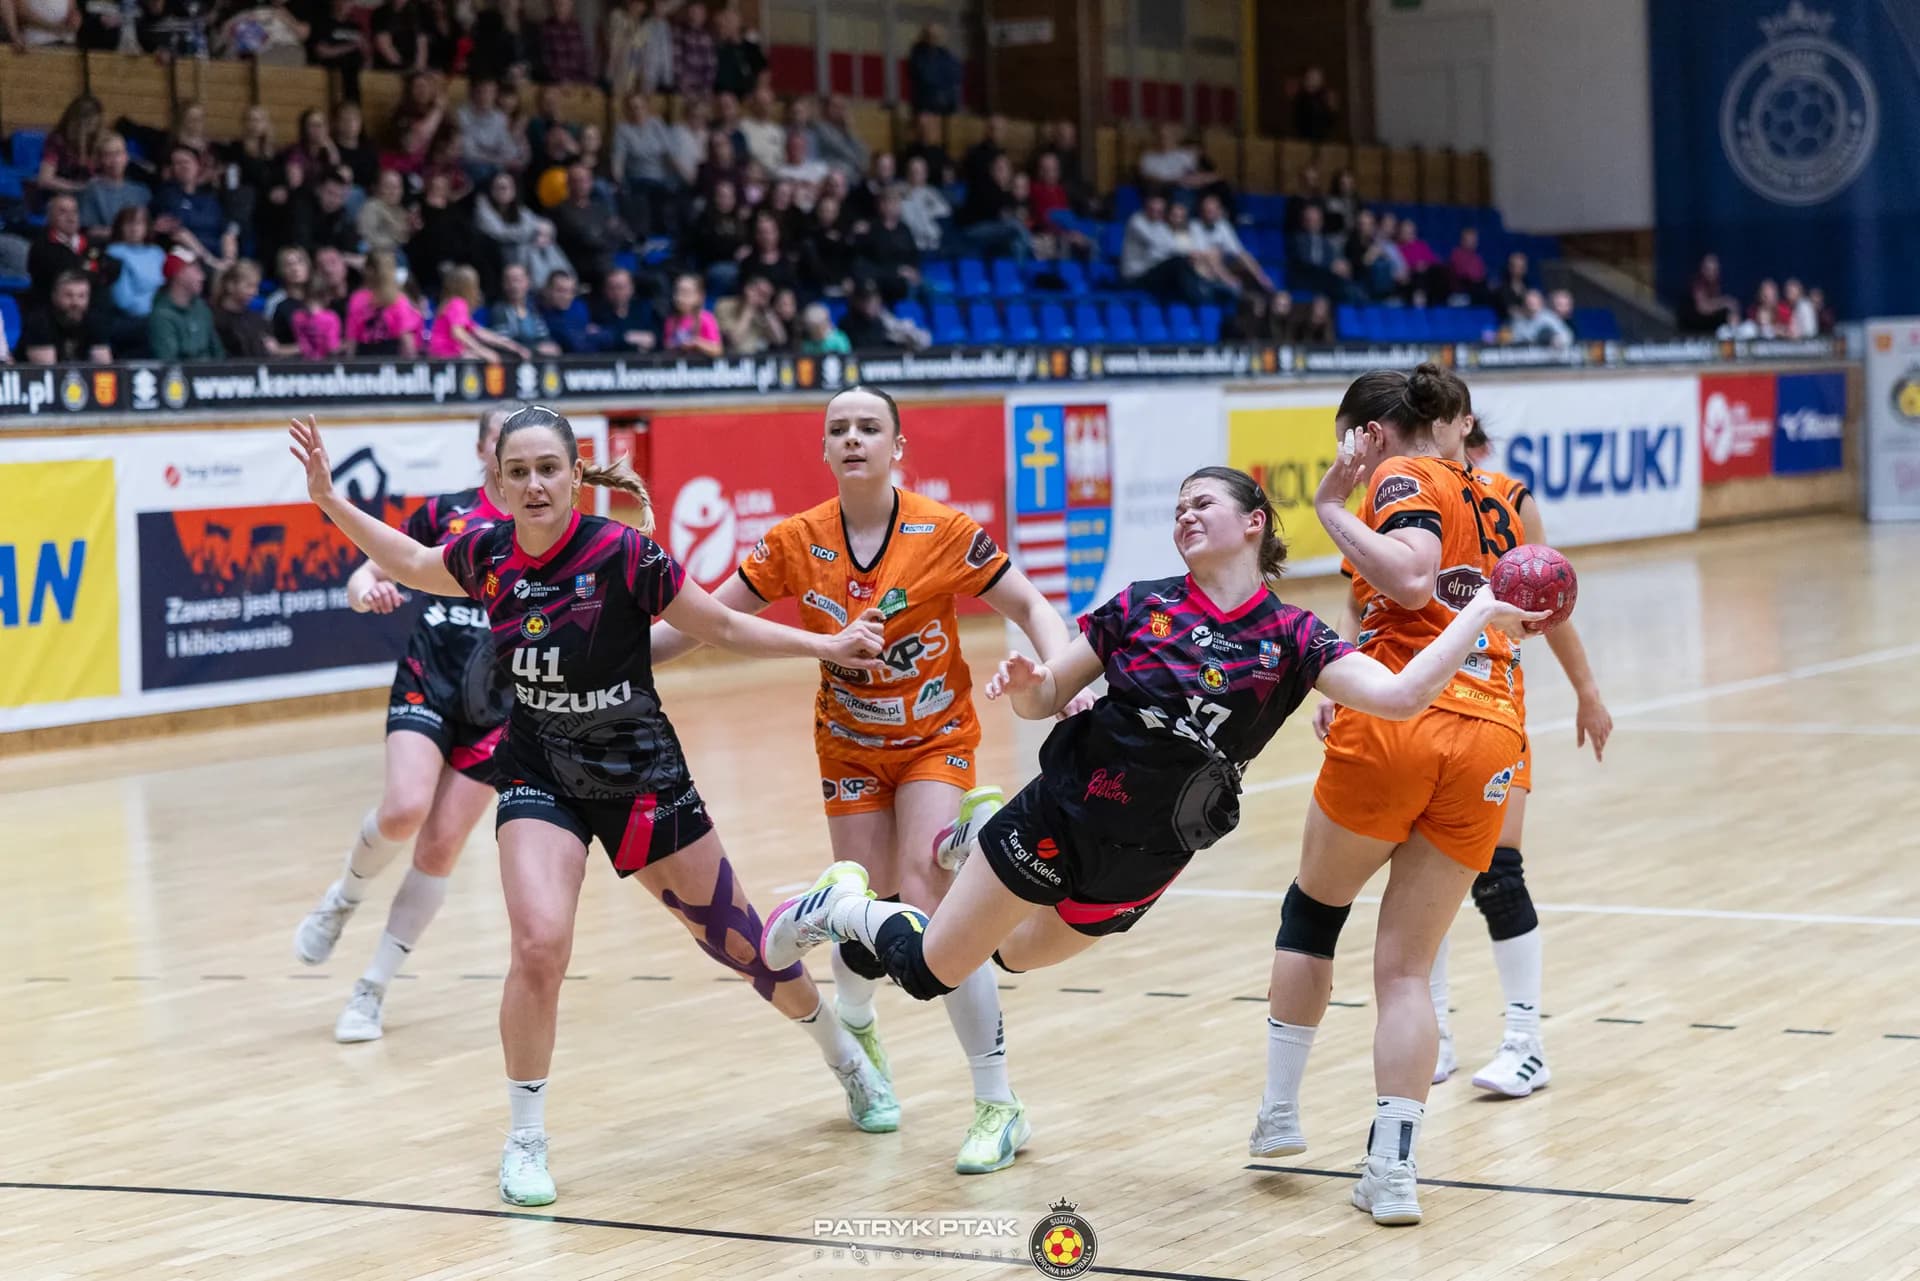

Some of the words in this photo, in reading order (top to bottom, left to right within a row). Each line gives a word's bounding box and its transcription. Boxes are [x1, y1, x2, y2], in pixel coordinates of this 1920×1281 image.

[0, 370, 54, 414] ll.pl
[193, 364, 456, 402] www.koronahandball.pl
[1507, 427, 1682, 499] SUZUKI
[1461, 486, 1517, 559] 13
[810, 544, 836, 561] TICO
[1447, 576, 1481, 597] elma
[165, 597, 241, 624] Zawsze
[243, 590, 280, 621] jest
[283, 589, 327, 617] pora
[167, 631, 176, 658] i
[178, 621, 293, 657] kibicowanie
[1151, 622, 1169, 637] CK
[1213, 638, 1243, 650] CENTRALNA
[511, 646, 564, 682] 41
[515, 679, 632, 713] SUZUKI
[946, 755, 968, 770] TICO
[842, 778, 879, 794] KPS
[1009, 828, 1033, 862] Targi
[1029, 858, 1062, 886] Kielce
